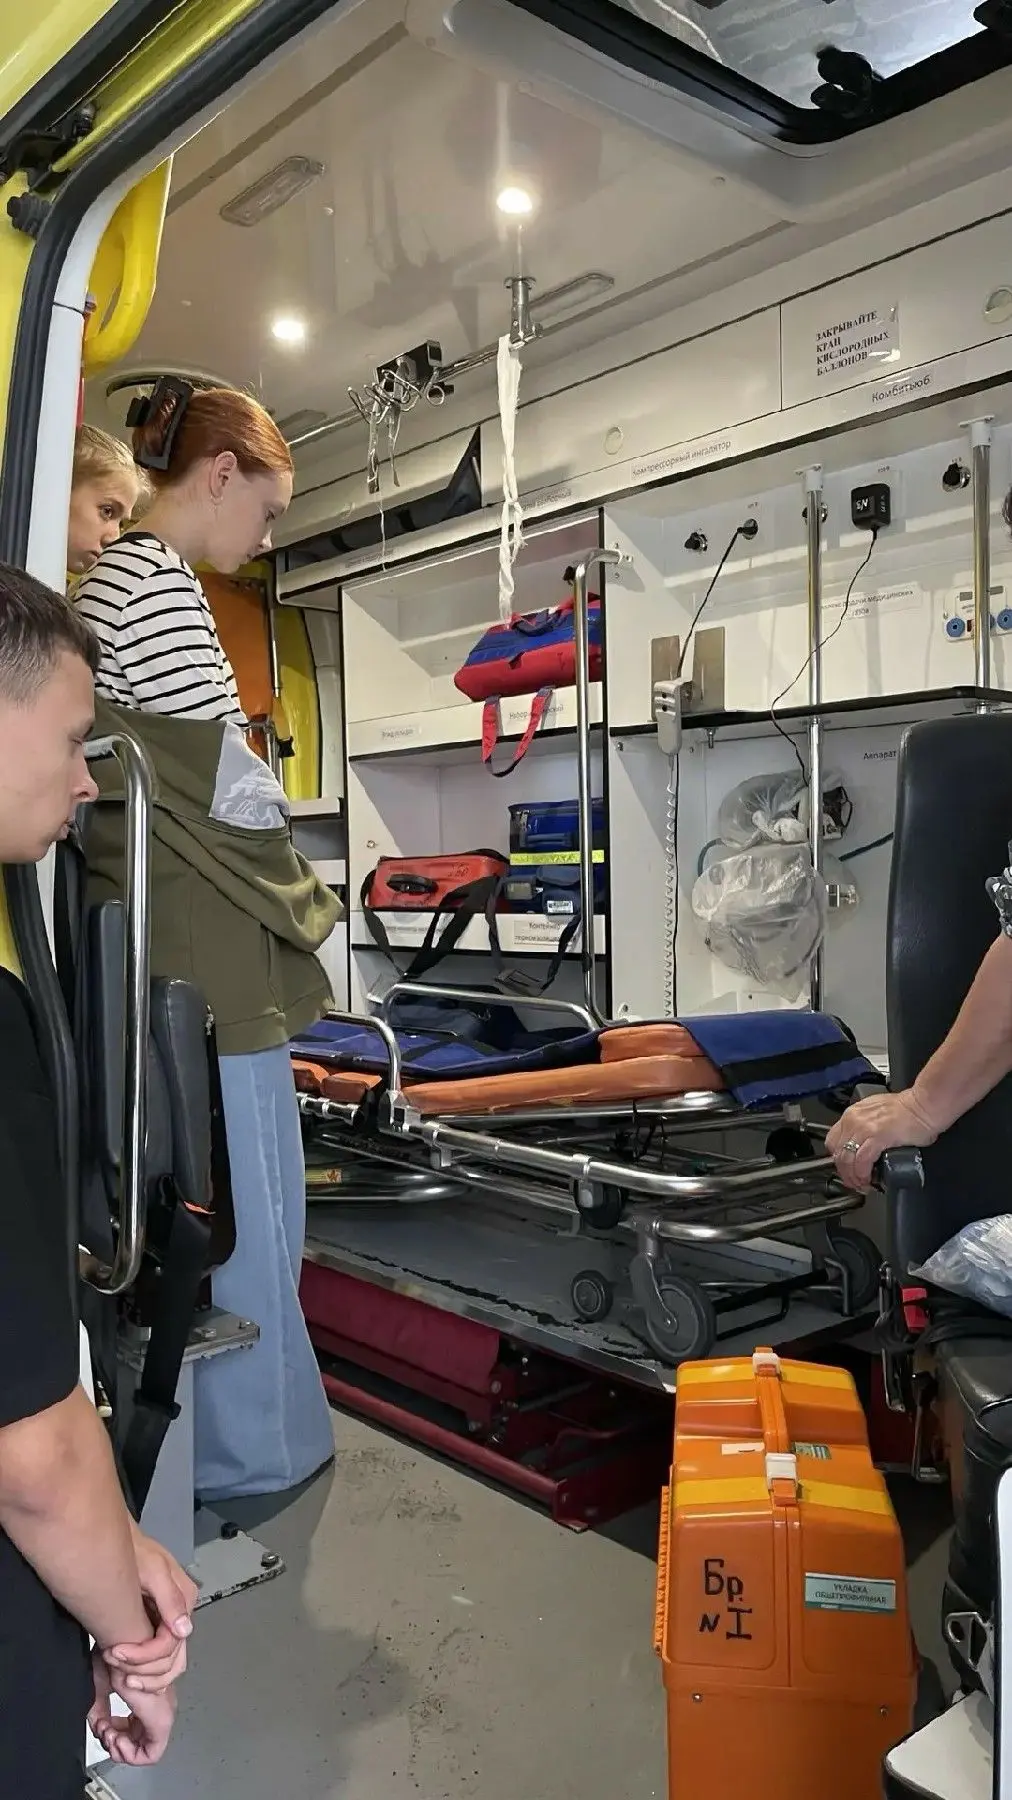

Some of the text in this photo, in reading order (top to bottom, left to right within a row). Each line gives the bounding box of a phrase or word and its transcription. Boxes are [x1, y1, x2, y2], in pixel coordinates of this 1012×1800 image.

[816, 311, 878, 341] ЗАКРЫВАЙТЕ
[816, 336, 841, 353] КРАН
[816, 331, 890, 365] КИСЛОРОДНЫХ
[816, 351, 868, 377] БАЛЛОНОВ
[872, 374, 931, 403] Комбитьюб
[863, 750, 896, 761] Аппарат
[833, 1583, 869, 1594] УКЛАДКА
